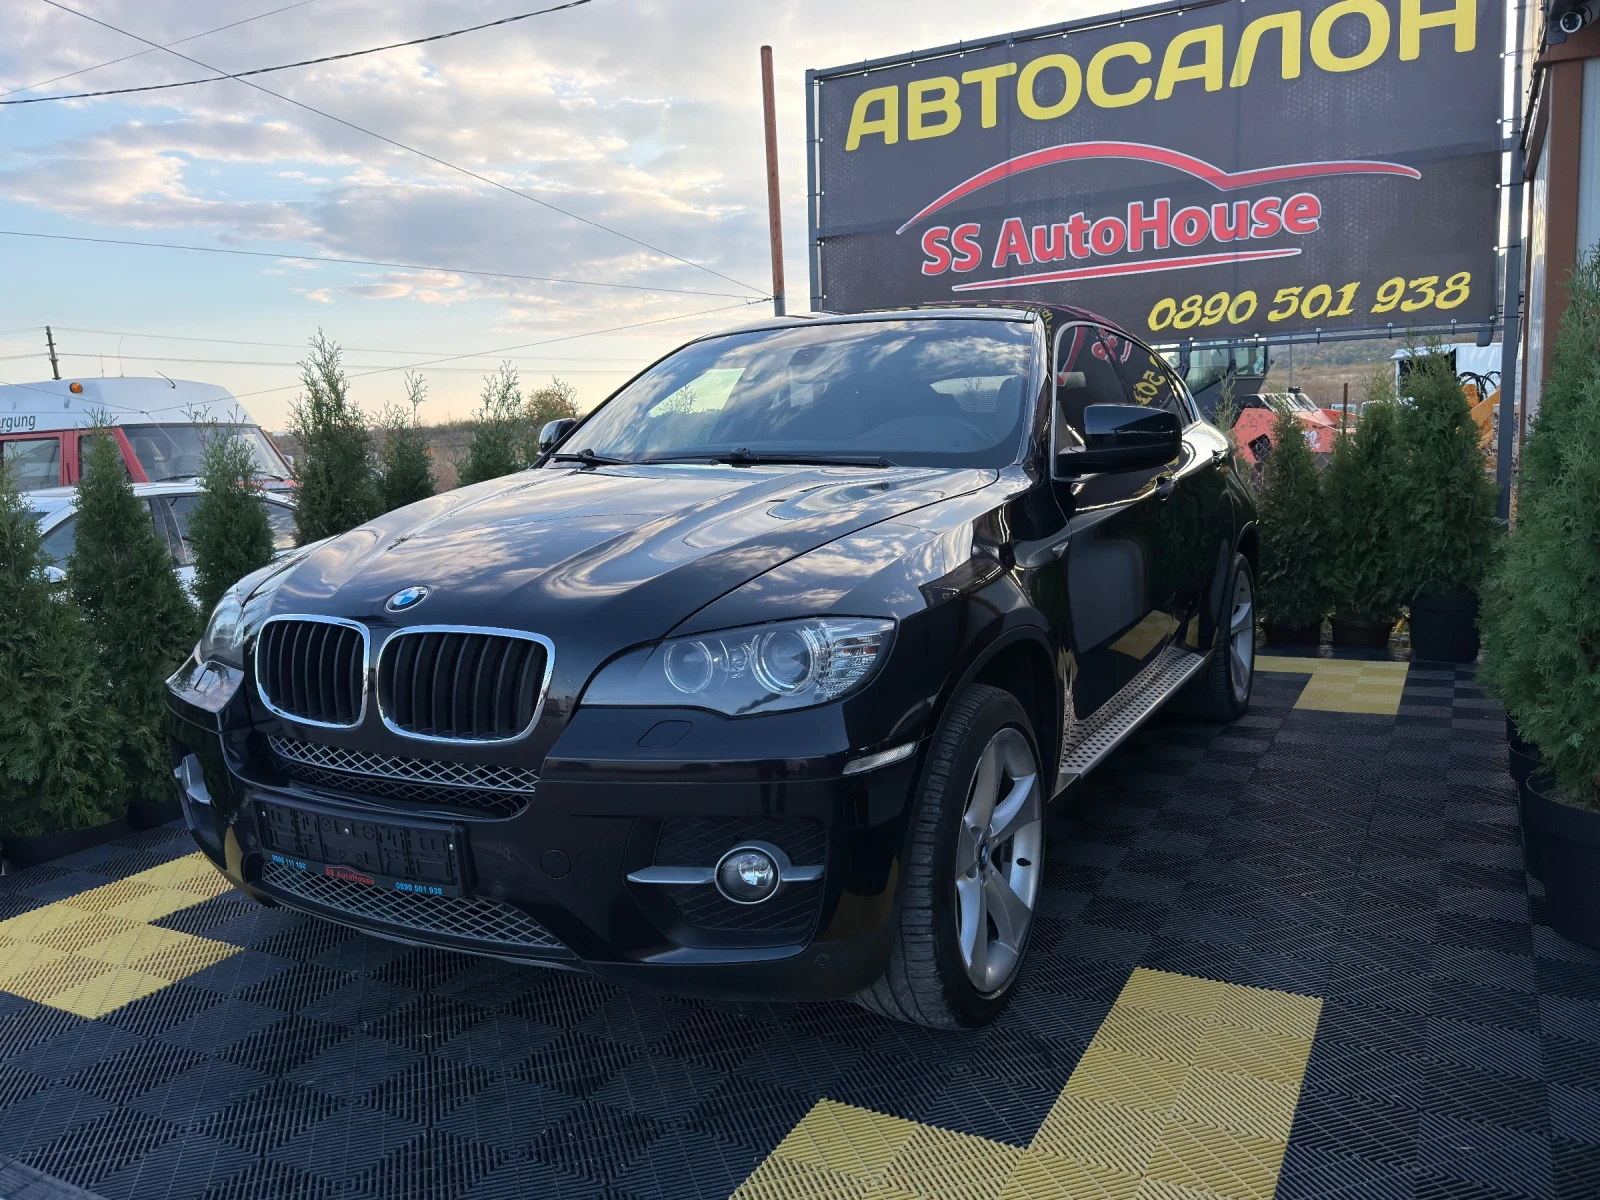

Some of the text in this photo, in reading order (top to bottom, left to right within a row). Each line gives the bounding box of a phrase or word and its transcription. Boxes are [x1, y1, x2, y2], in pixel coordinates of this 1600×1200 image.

[845, 0, 1477, 151] АВТОСАЛОН
[921, 193, 1322, 275] SS AutoHouse
[1148, 271, 1472, 331] 0890 501 938
[0, 415, 36, 432] rgung
[336, 870, 375, 886] AutoHouse
[414, 884, 427, 893] 501
